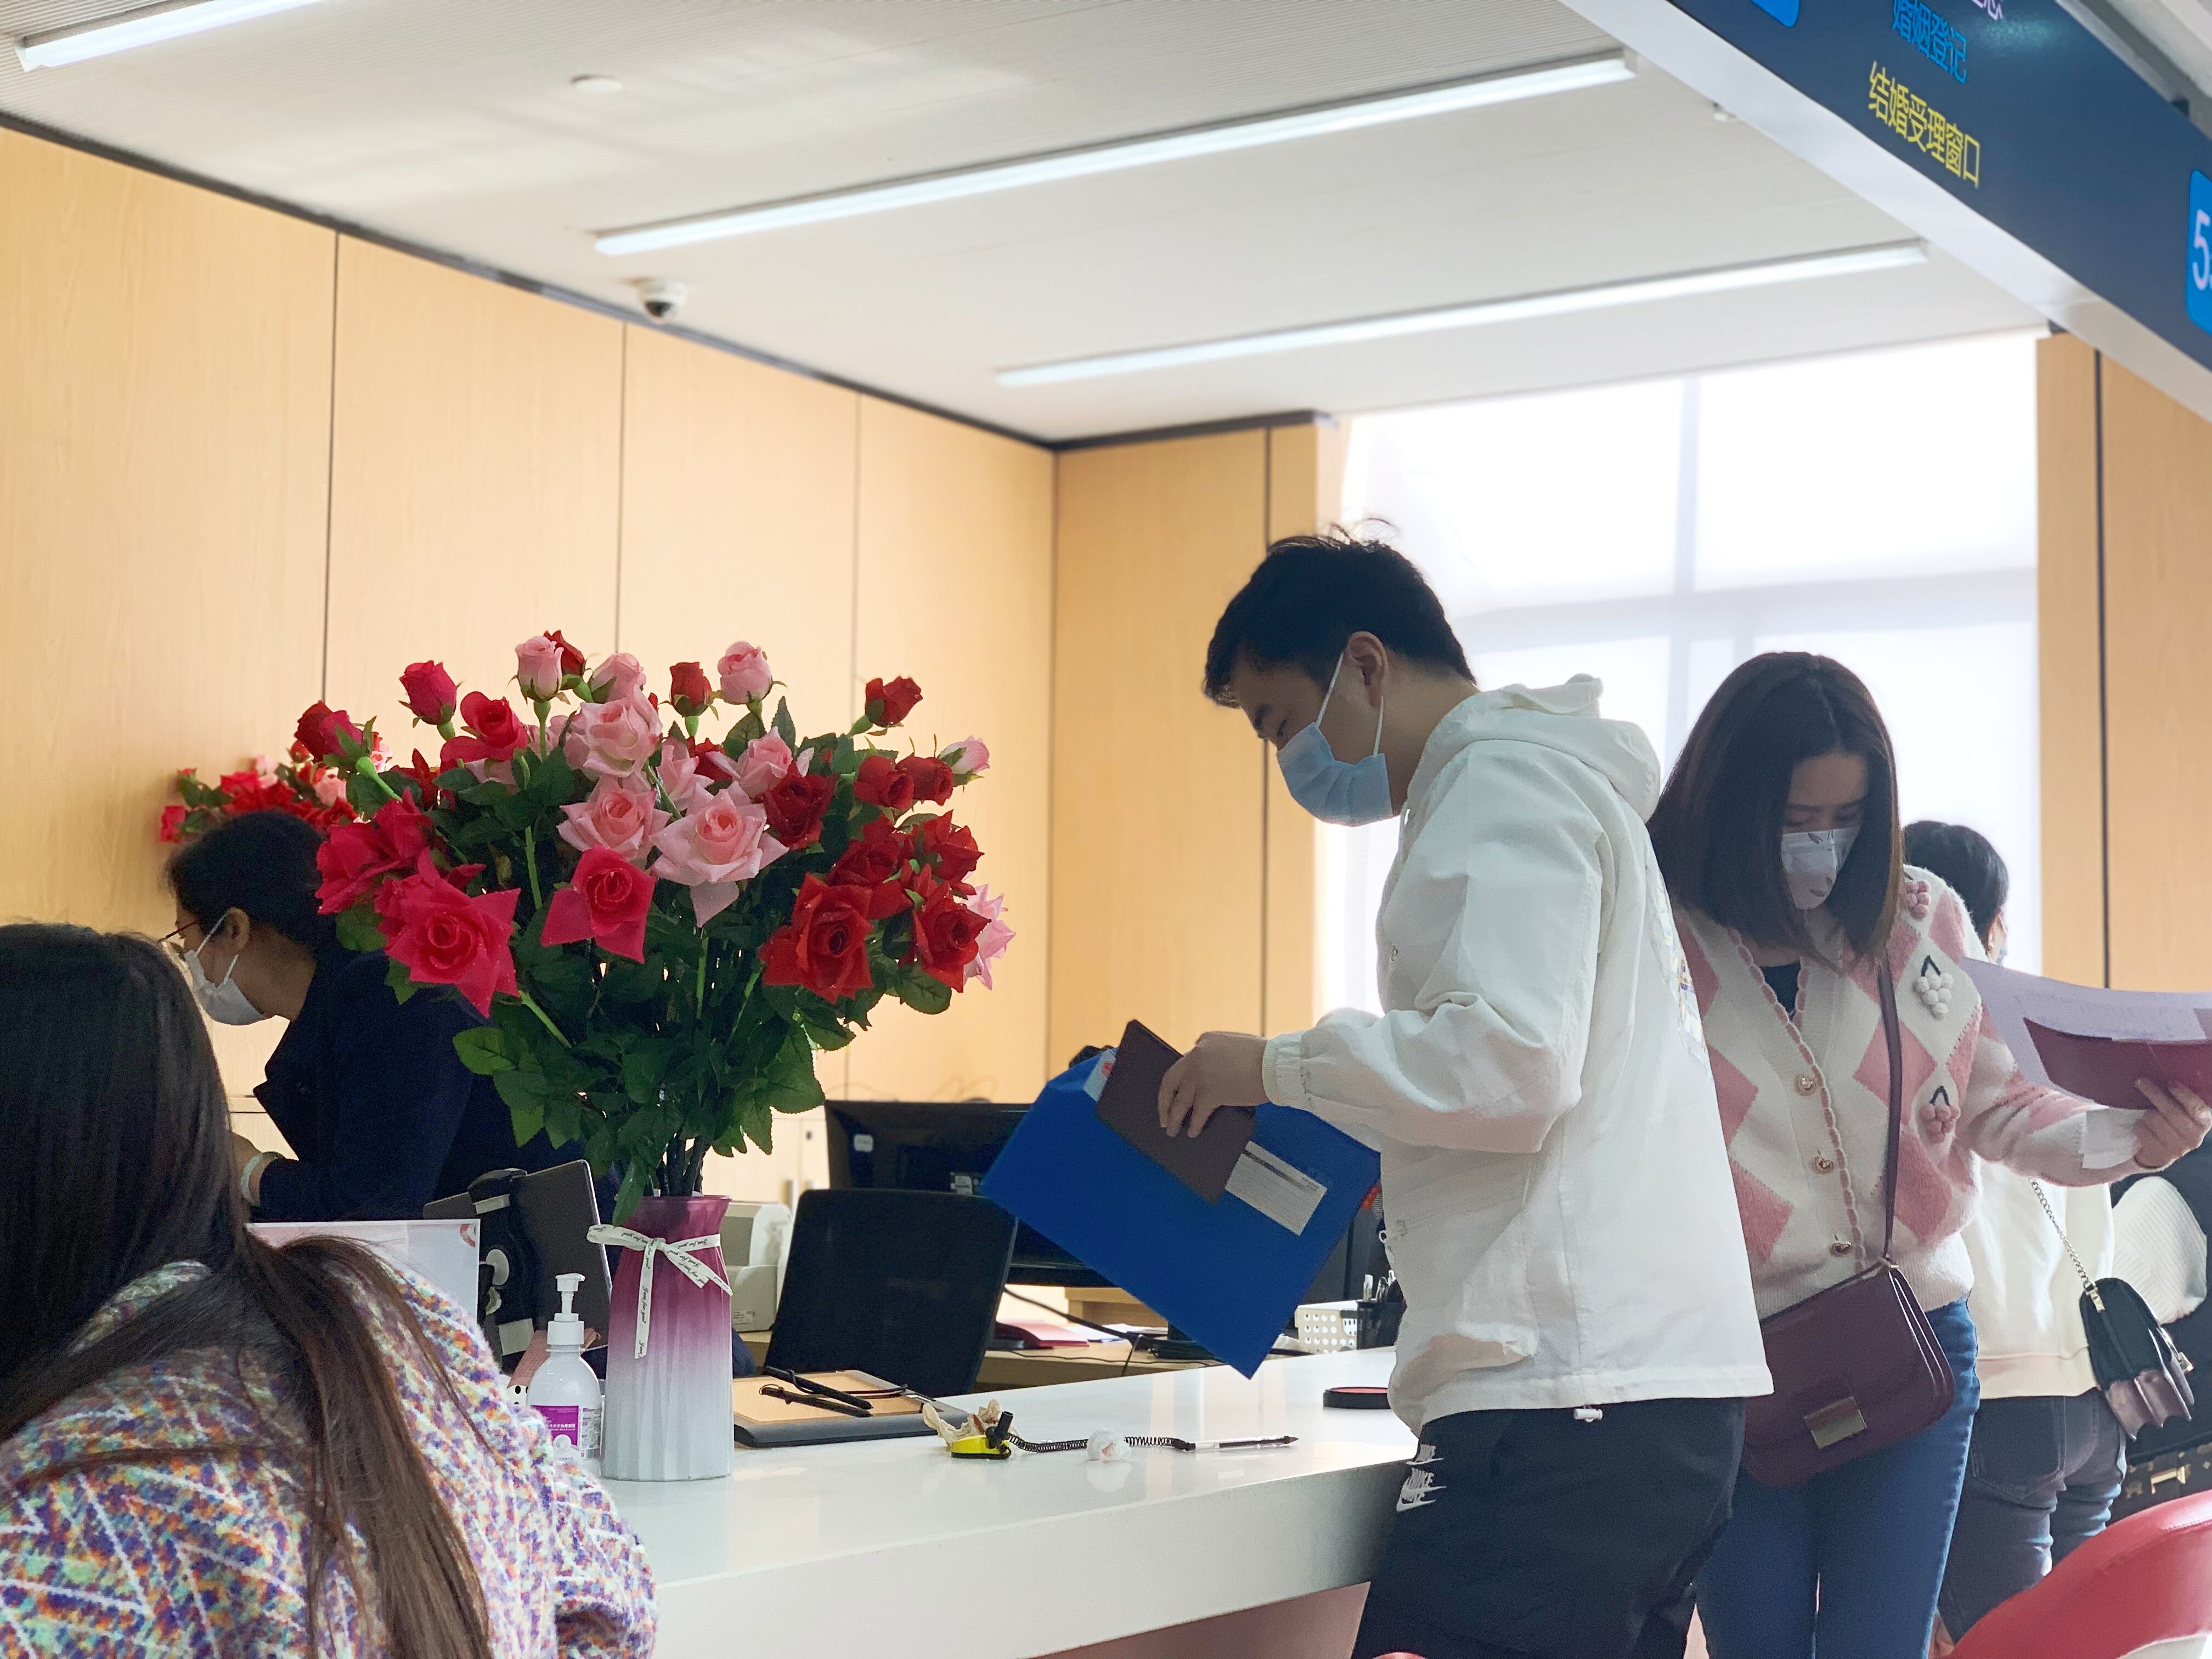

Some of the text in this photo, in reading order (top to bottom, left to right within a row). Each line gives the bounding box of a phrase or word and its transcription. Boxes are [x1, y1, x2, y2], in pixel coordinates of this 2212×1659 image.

[1869, 60, 1979, 188] 结婚受理窗口
[2192, 209, 2212, 290] 5
